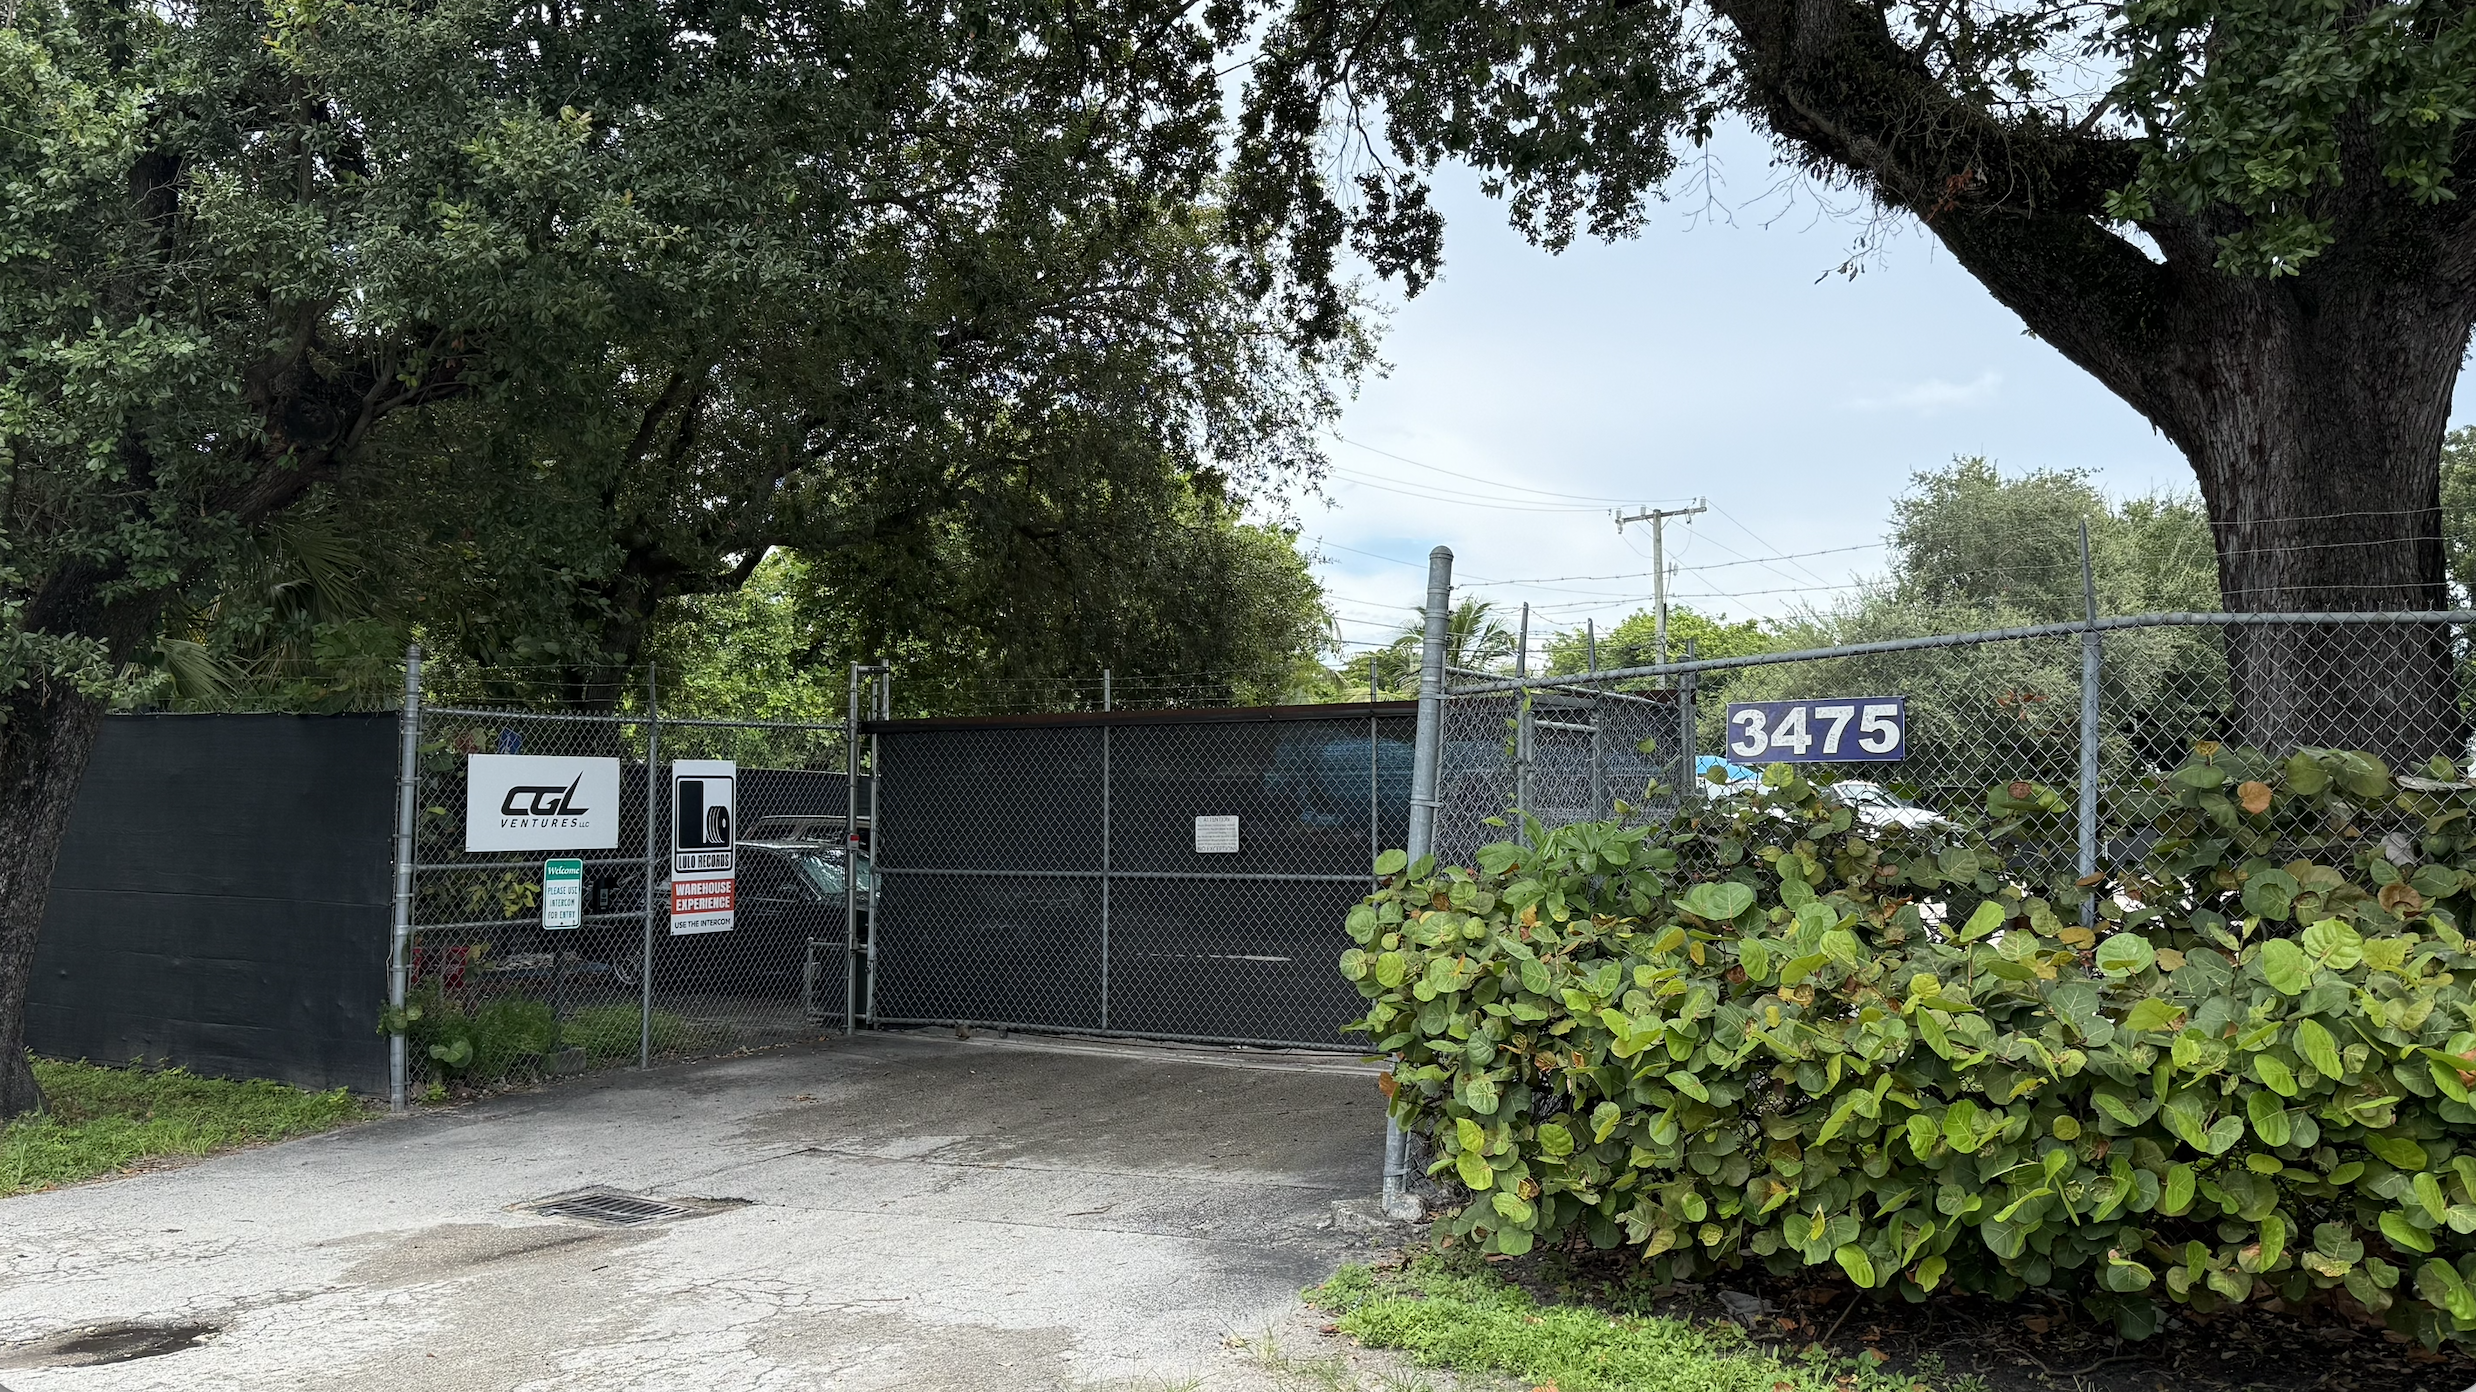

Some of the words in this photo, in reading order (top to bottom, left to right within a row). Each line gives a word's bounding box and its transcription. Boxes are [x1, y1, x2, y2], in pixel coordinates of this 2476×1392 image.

[1730, 703, 1901, 757] 3475
[500, 769, 590, 816] CGL
[500, 818, 578, 829] VENTURES
[678, 854, 696, 869] LULO
[697, 853, 730, 868] RECORDS
[547, 865, 580, 875] Welcome
[547, 886, 566, 895] PLEASE
[567, 886, 578, 895] USE
[675, 881, 732, 896] WAREHOUSE
[549, 898, 575, 907] INTERCOM
[675, 896, 731, 912] EXPERIENCE
[547, 911, 558, 919] FOR
[560, 910, 576, 919] ENTRY
[674, 920, 687, 929] USE
[688, 920, 699, 928] THE
[700, 918, 731, 927] INTERCOM
